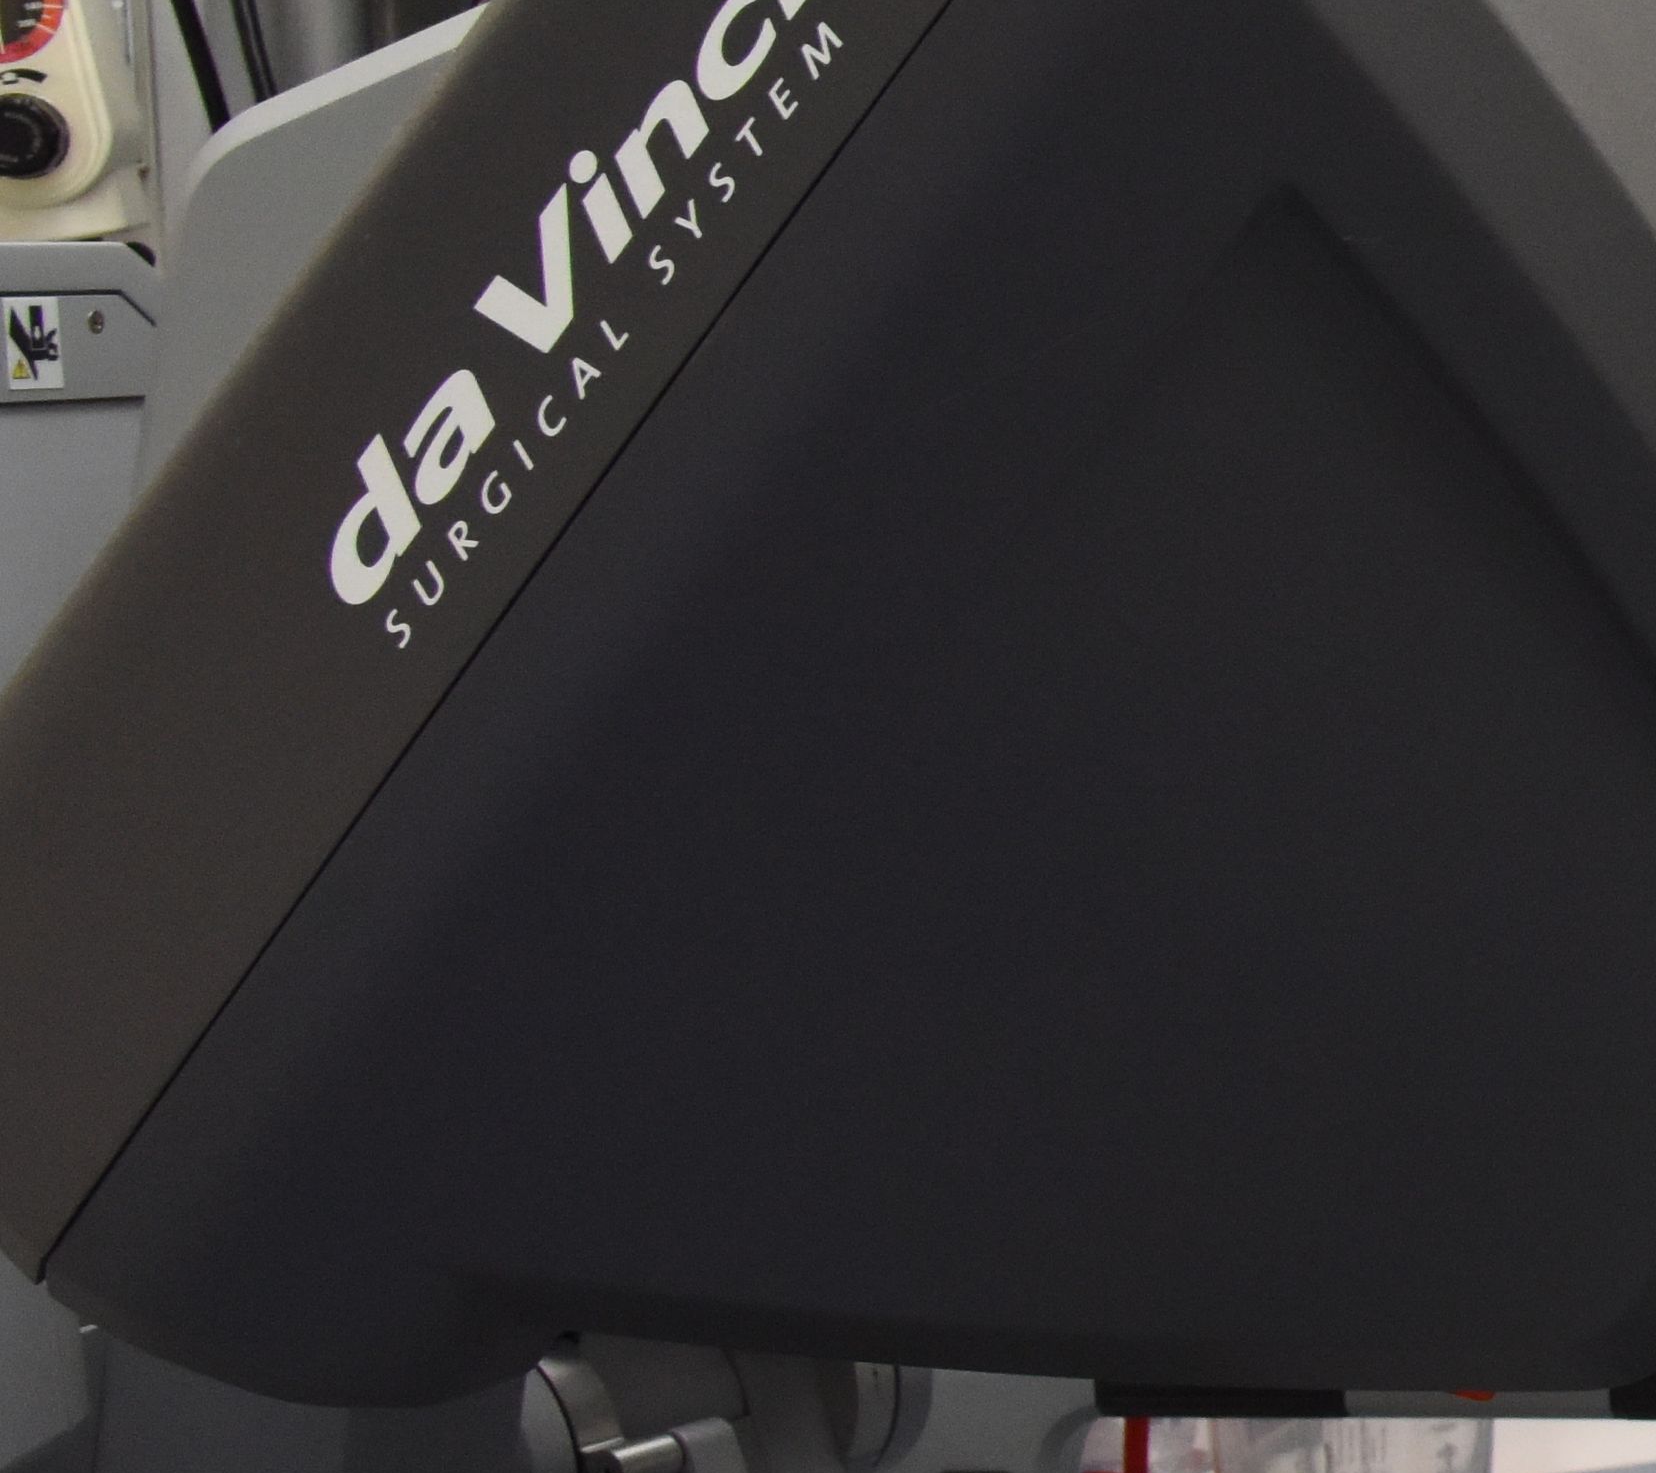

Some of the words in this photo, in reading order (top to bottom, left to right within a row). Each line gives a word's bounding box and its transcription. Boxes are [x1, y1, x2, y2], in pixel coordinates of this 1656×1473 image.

[330, 368, 496, 606] da
[385, 320, 630, 649] SURGICAL
[648, 21, 844, 286] SYSTEM
